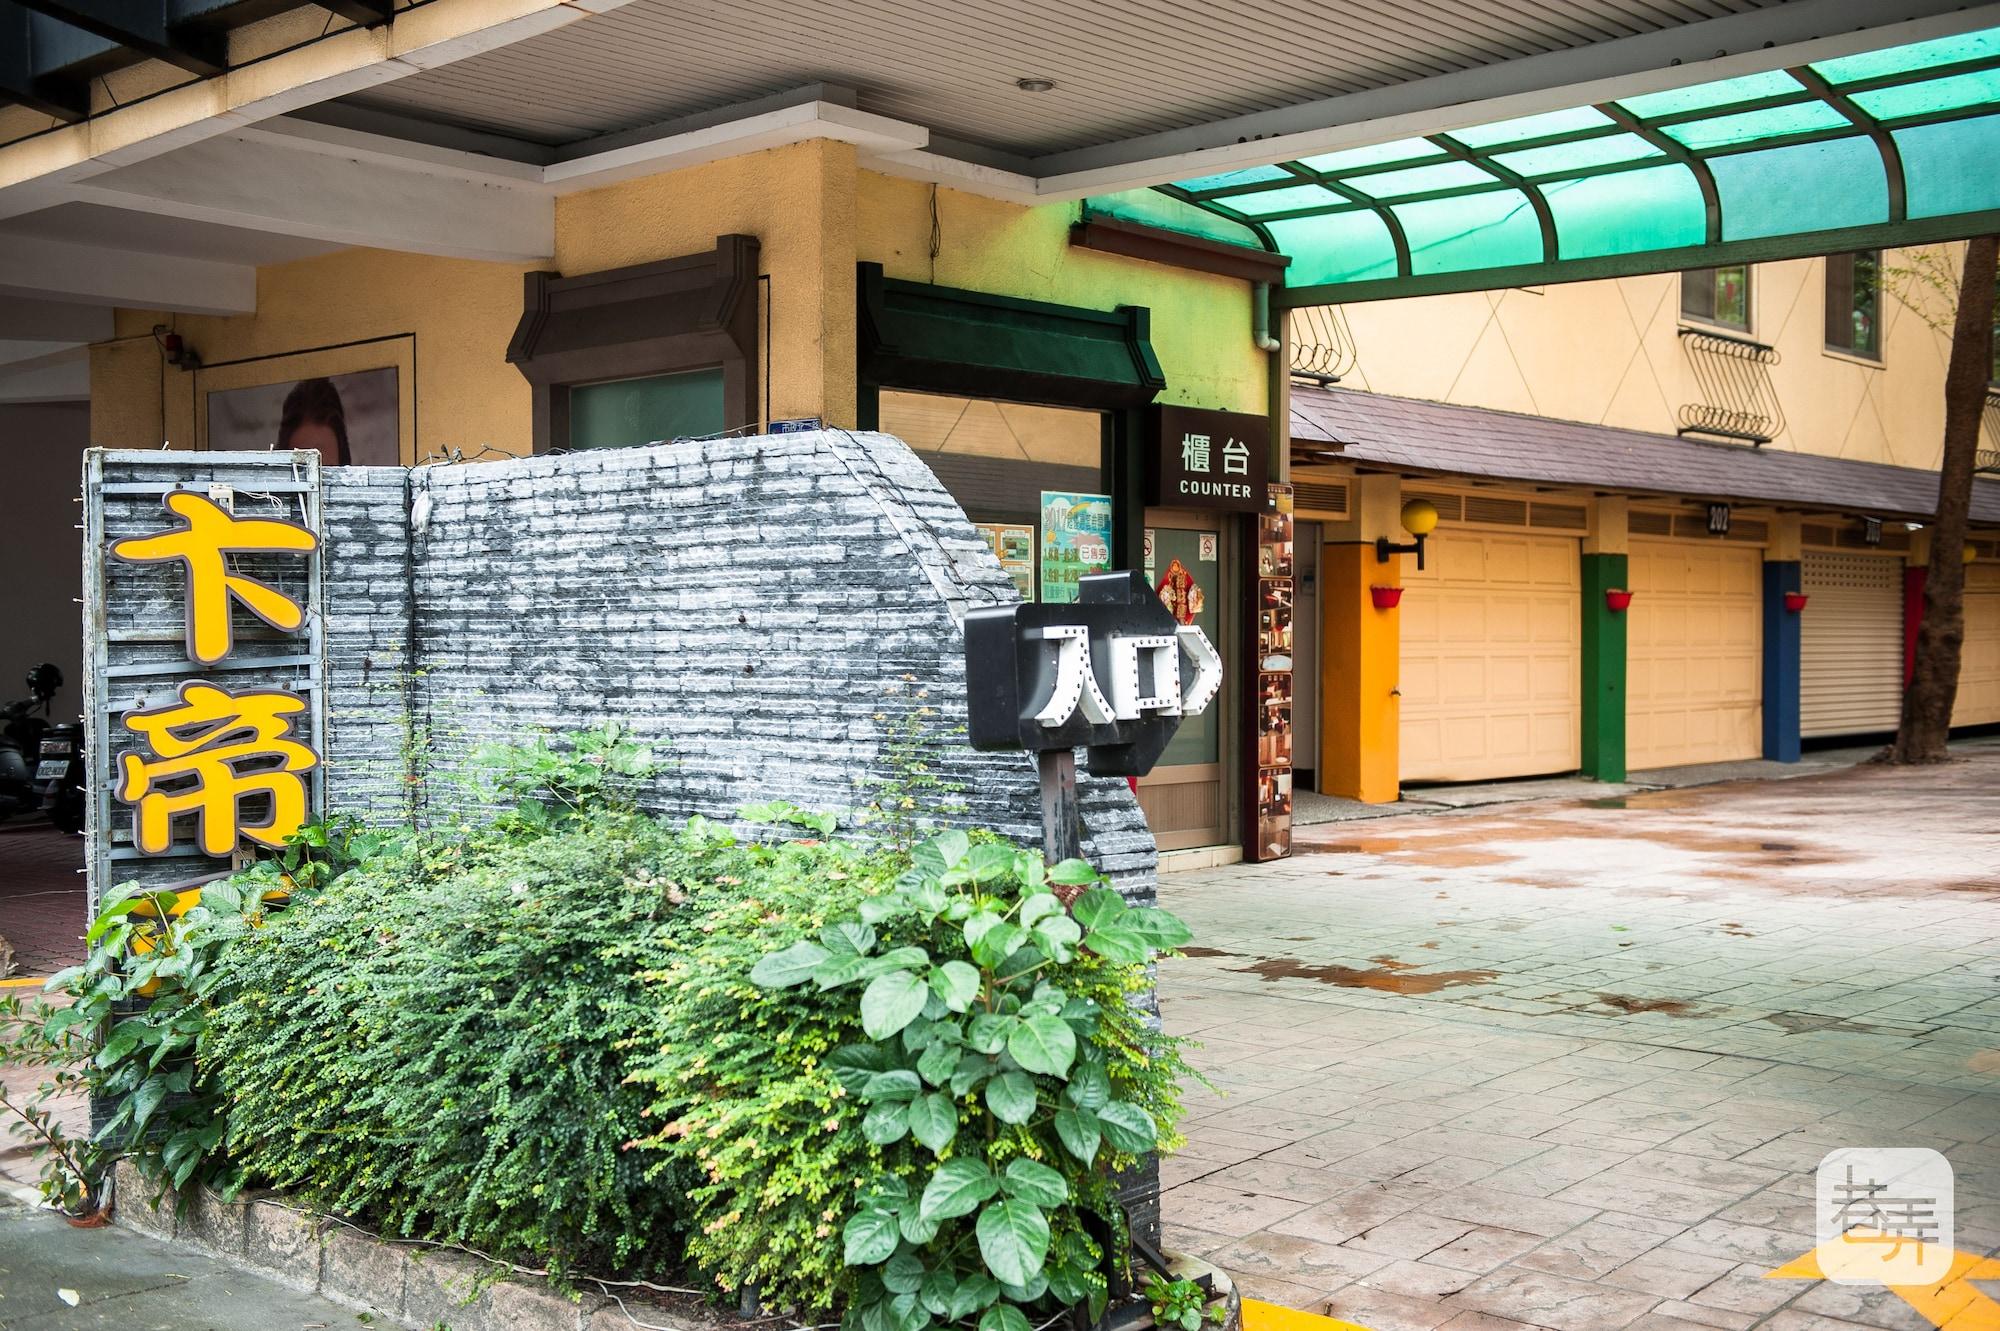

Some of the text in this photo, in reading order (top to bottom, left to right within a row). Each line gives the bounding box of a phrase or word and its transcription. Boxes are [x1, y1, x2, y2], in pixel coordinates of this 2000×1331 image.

[1181, 432, 1251, 476] 櫃台
[1179, 479, 1252, 498] COUNTER
[1709, 505, 1728, 531] 202
[1034, 624, 1182, 728] 入口
